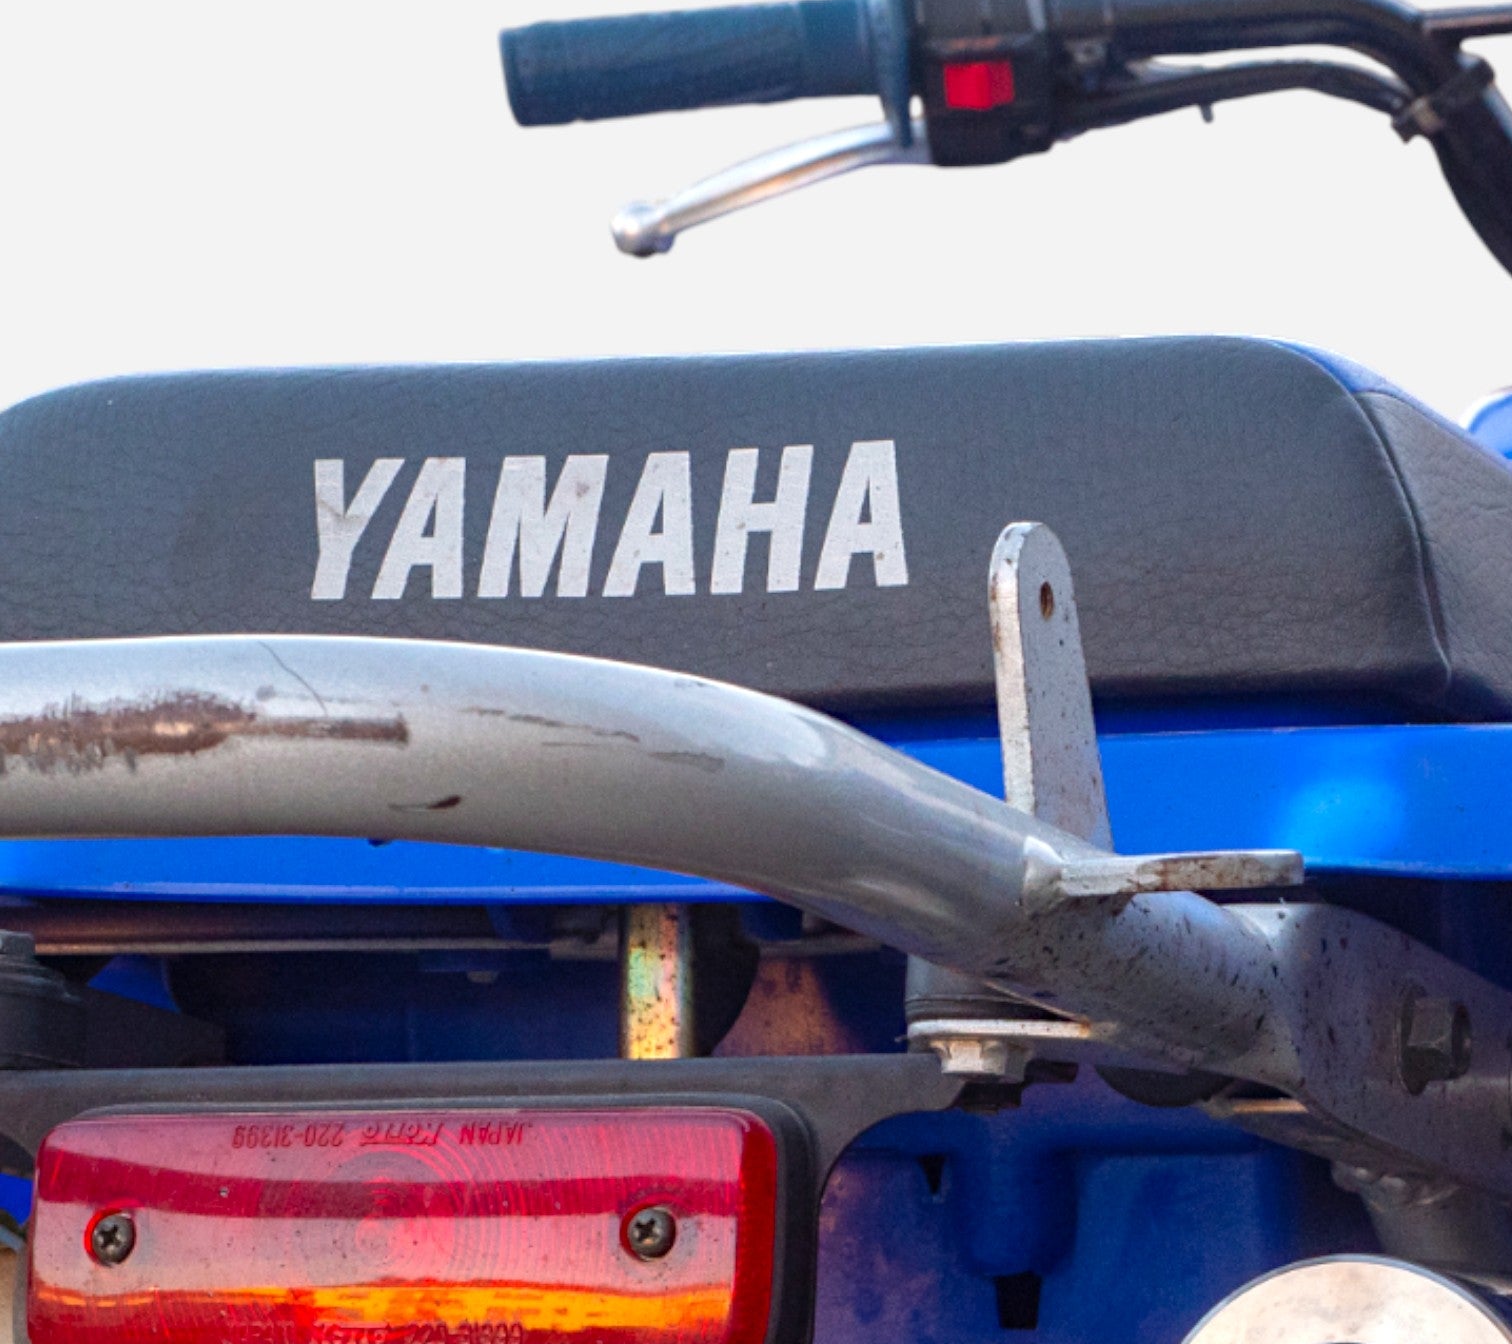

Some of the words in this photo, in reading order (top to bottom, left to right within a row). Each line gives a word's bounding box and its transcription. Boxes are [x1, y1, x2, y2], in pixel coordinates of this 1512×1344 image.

[310, 439, 909, 600] YAMAHA
[231, 1121, 345, 1149] 220-31399
[458, 1122, 532, 1147] JAPAN
